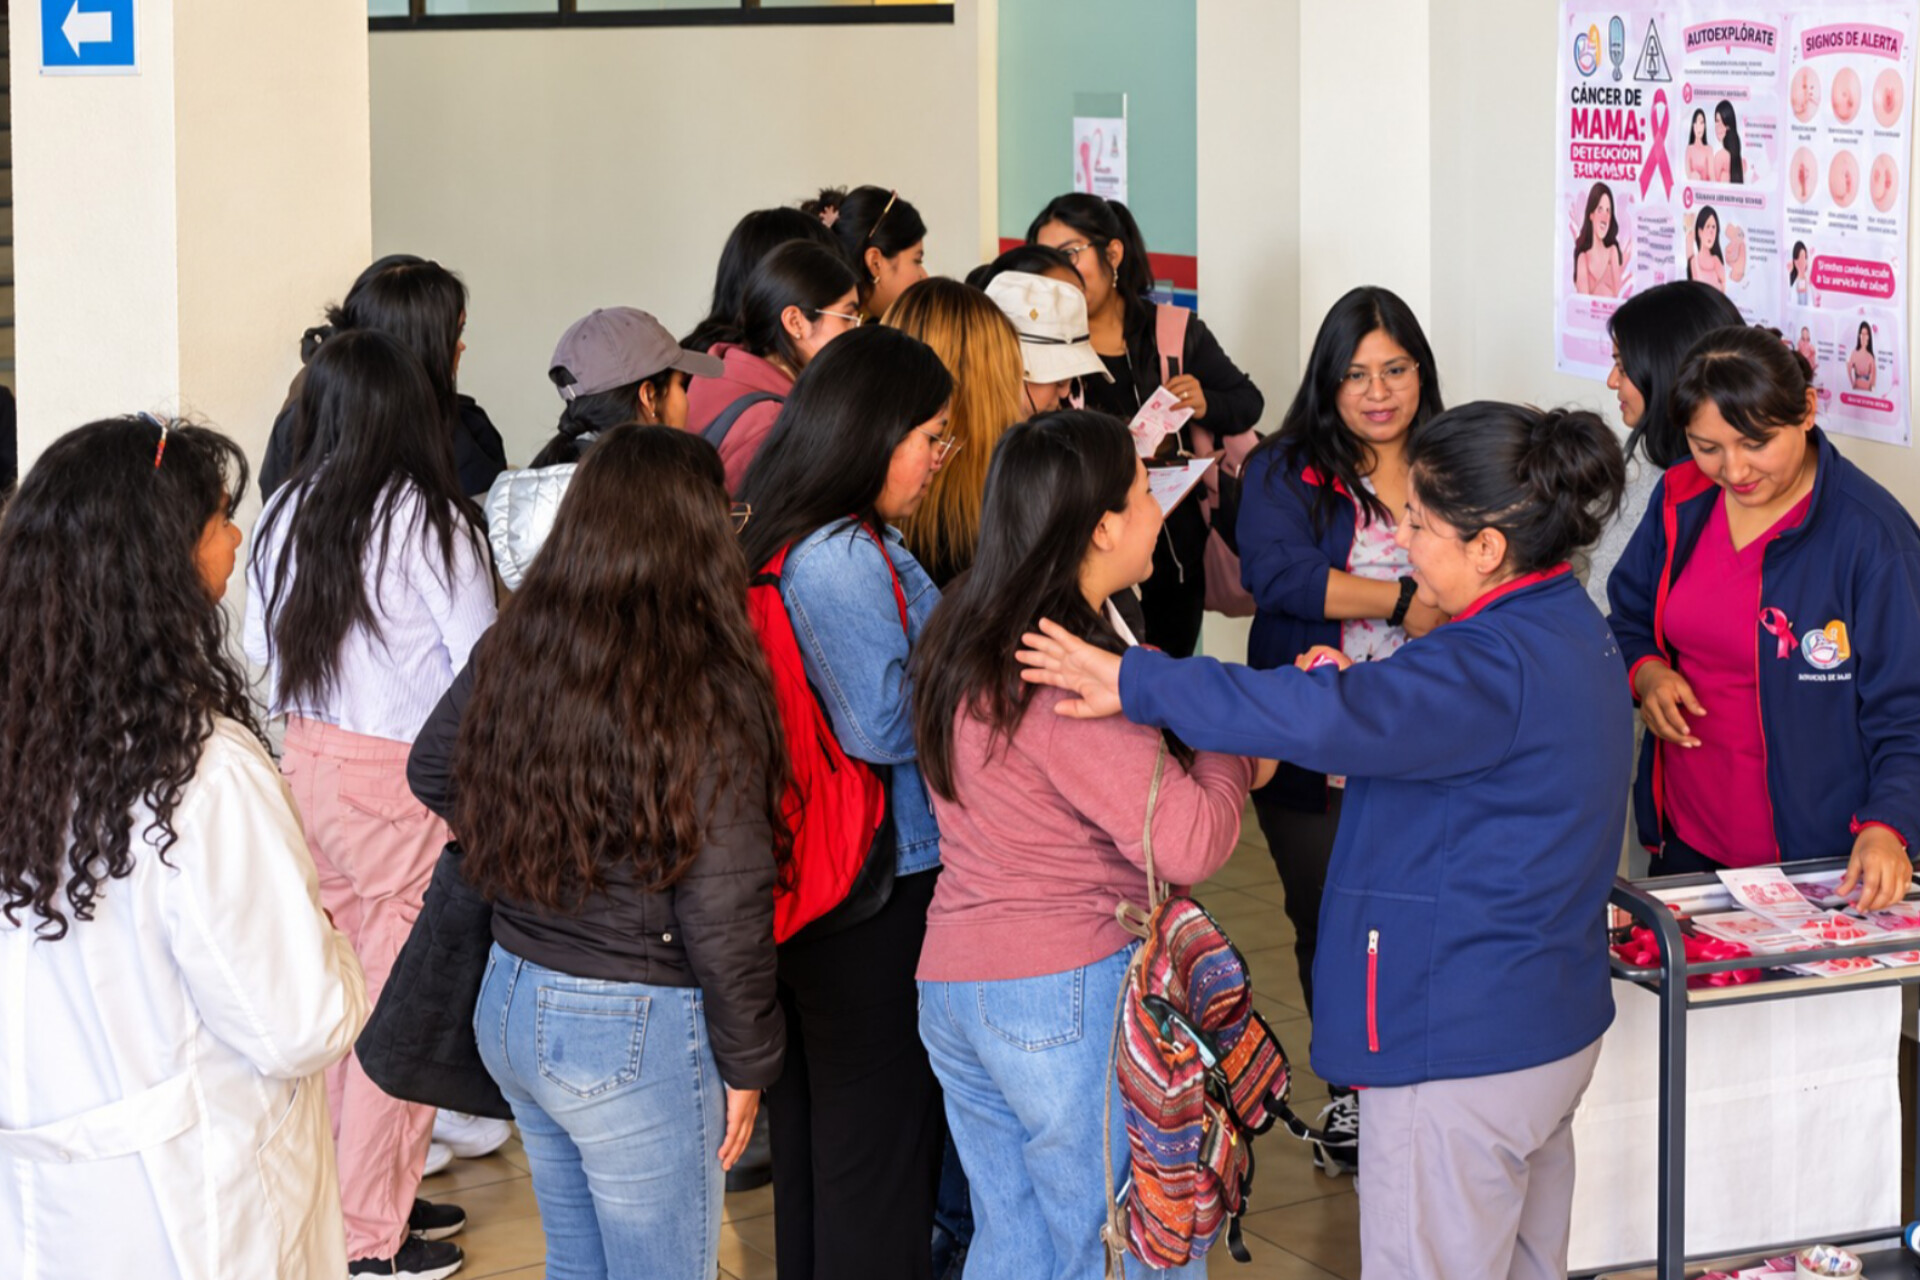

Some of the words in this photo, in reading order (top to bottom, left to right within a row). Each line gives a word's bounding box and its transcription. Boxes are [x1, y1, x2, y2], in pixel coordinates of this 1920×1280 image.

[1687, 22, 1774, 47] AUTOEXPLÓRATE
[1805, 31, 1844, 52] SIGNOS
[1845, 31, 1859, 46] DE
[1861, 32, 1898, 53] ALERTA
[1571, 81, 1622, 105] CÁNCER
[1624, 88, 1642, 106] DE
[1571, 107, 1646, 142] MAMA:
